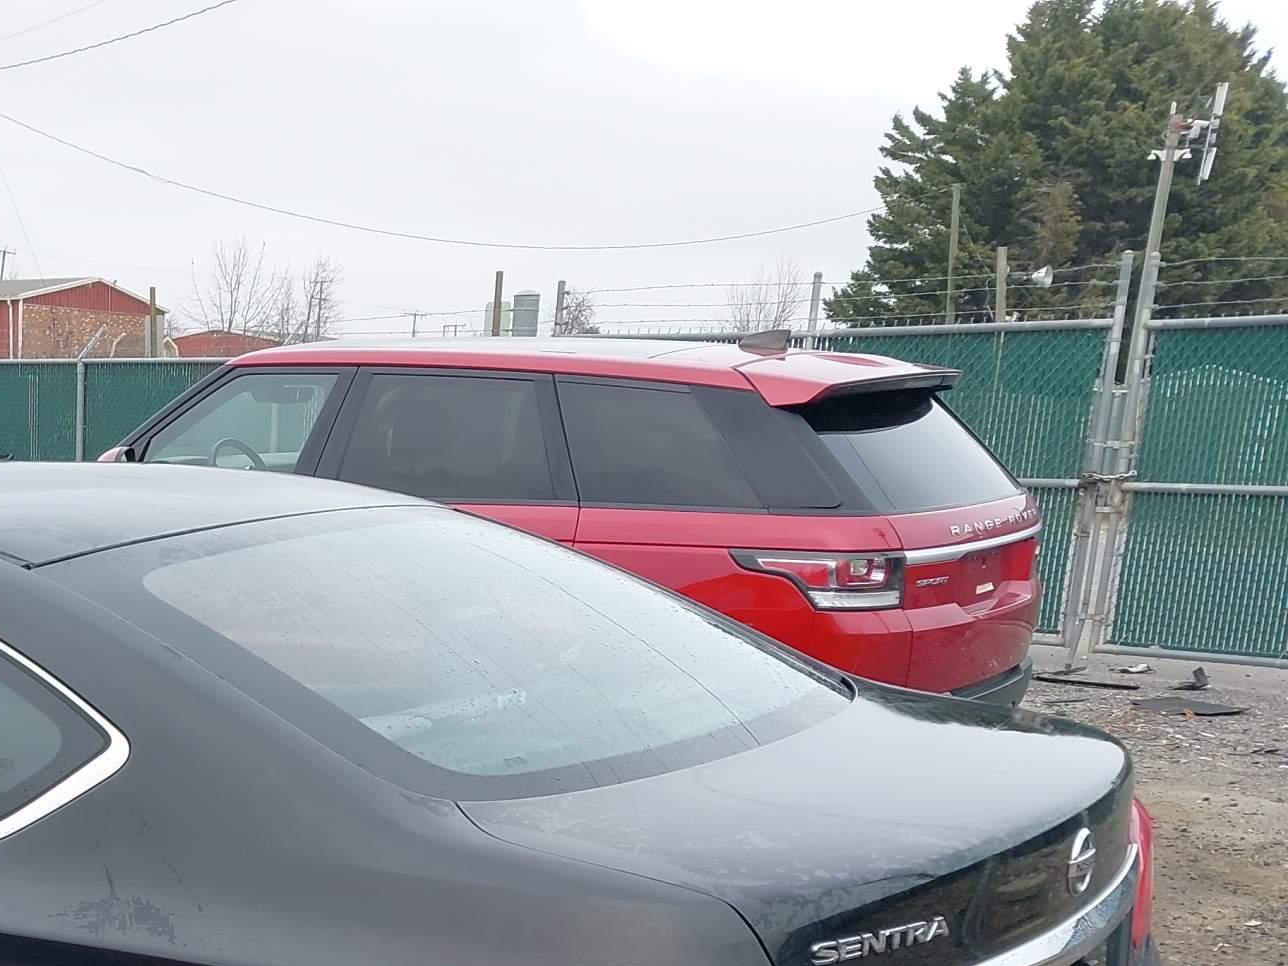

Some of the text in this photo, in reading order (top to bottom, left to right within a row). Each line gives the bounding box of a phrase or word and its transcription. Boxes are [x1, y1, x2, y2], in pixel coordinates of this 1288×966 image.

[950, 518, 1002, 537] RANGE
[915, 575, 950, 588] SPORT
[811, 915, 950, 966] SENTRA
